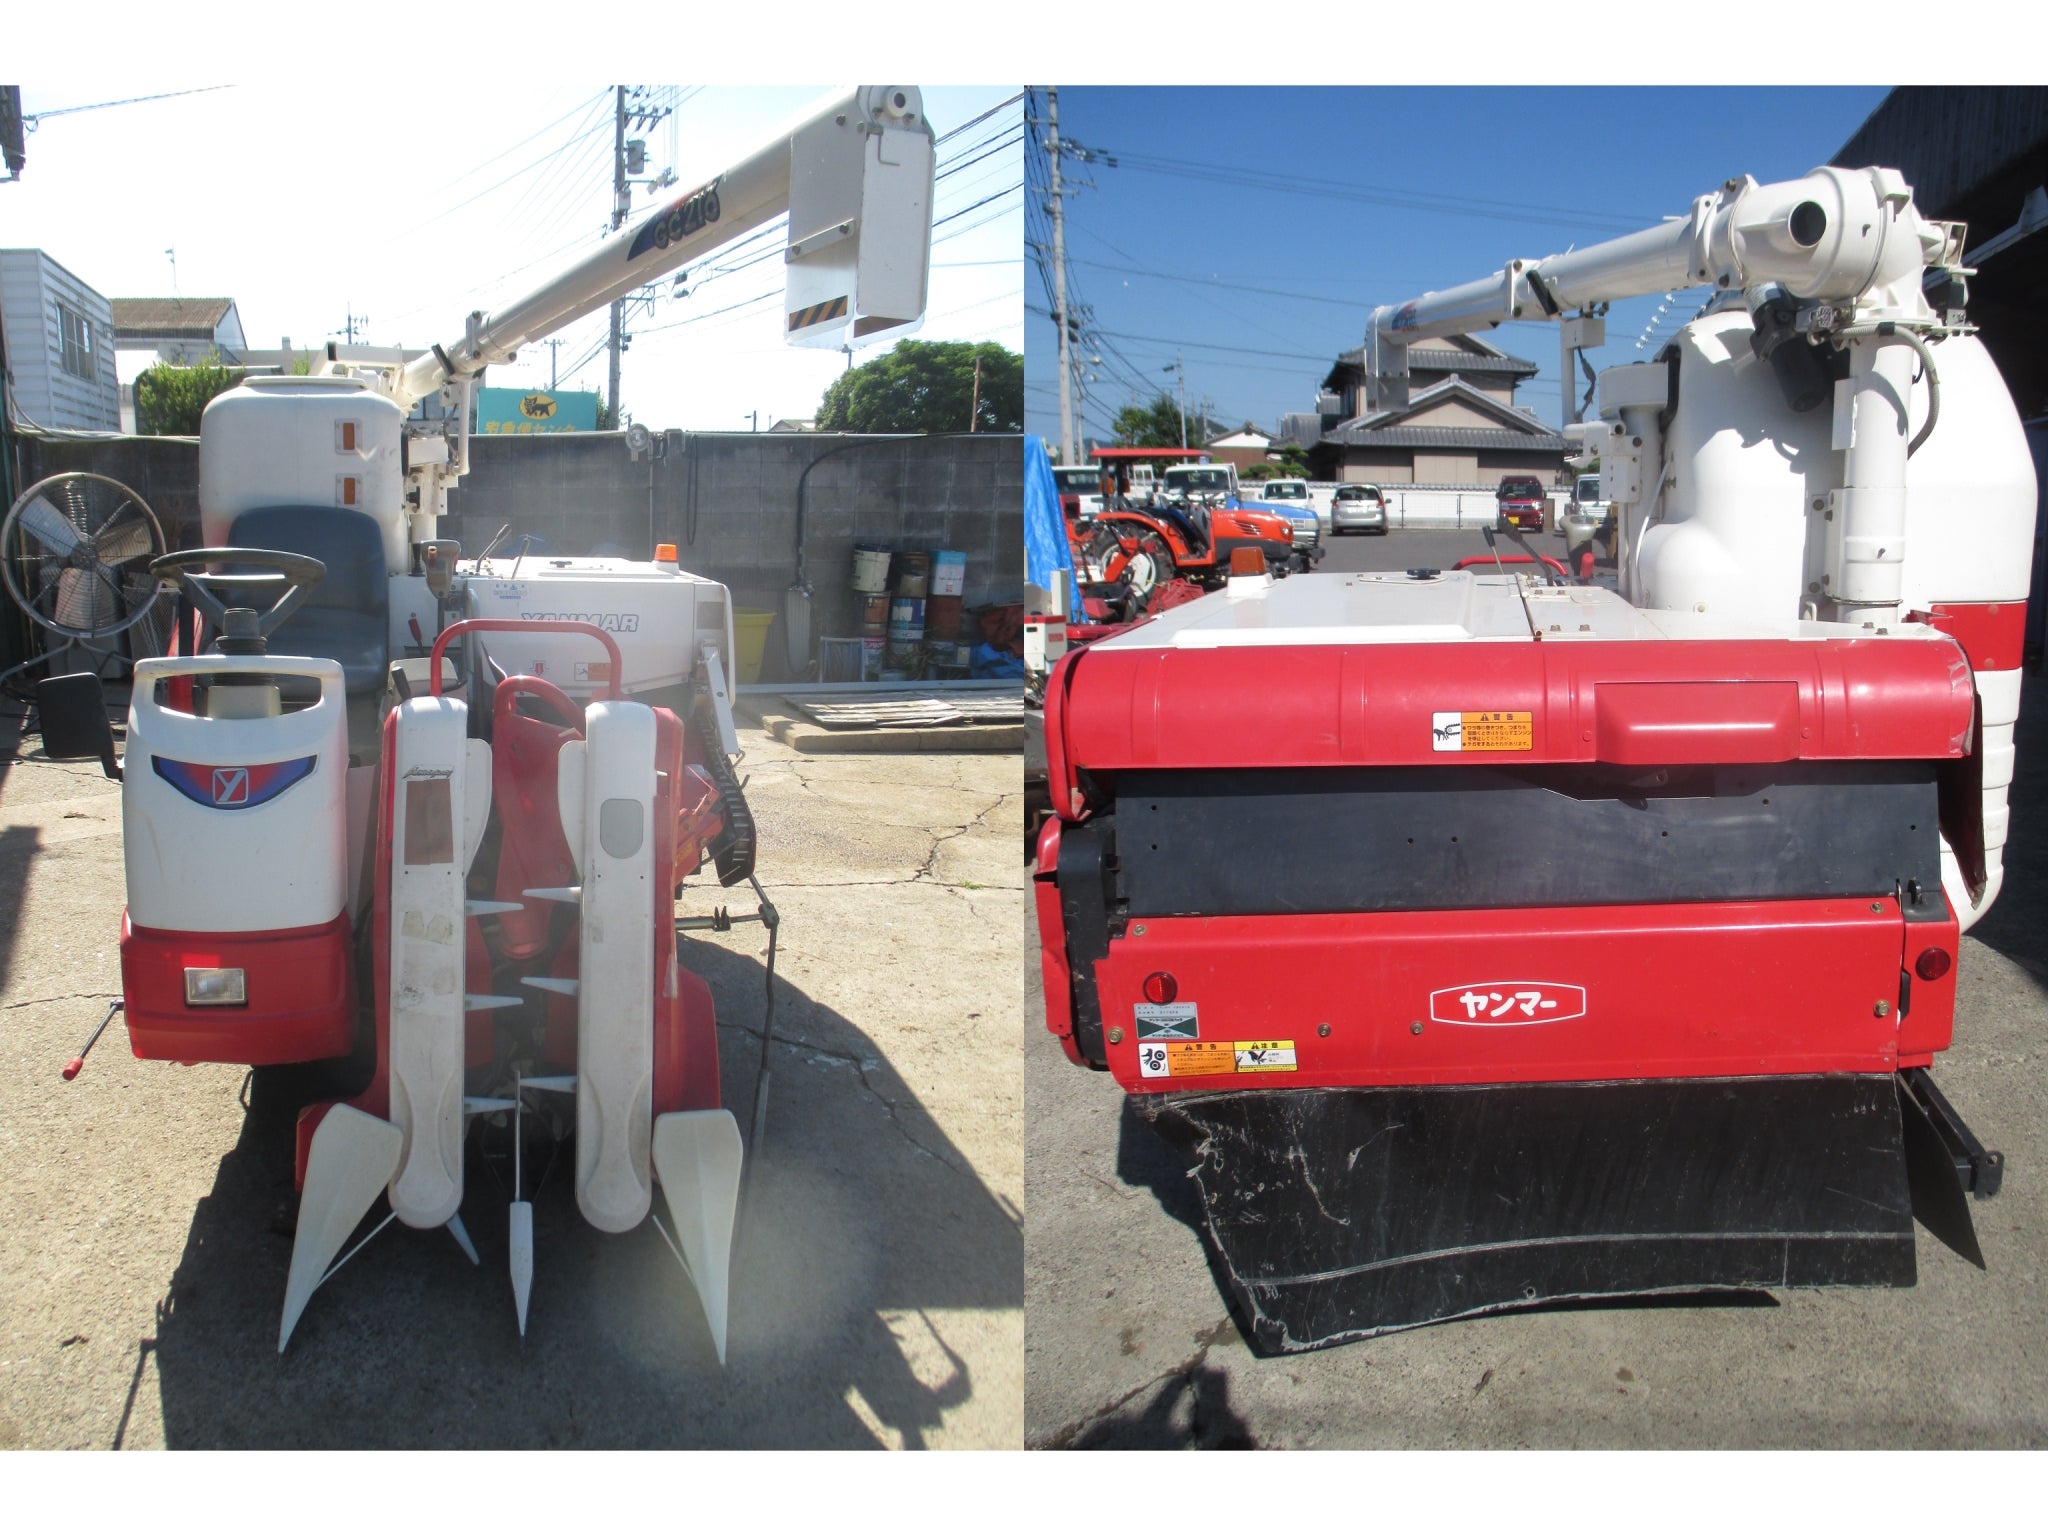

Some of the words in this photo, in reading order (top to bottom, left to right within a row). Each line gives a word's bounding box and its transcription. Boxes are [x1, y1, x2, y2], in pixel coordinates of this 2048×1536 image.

[653, 184, 720, 250] GC210
[1459, 991, 1557, 1019] ヤンマー
